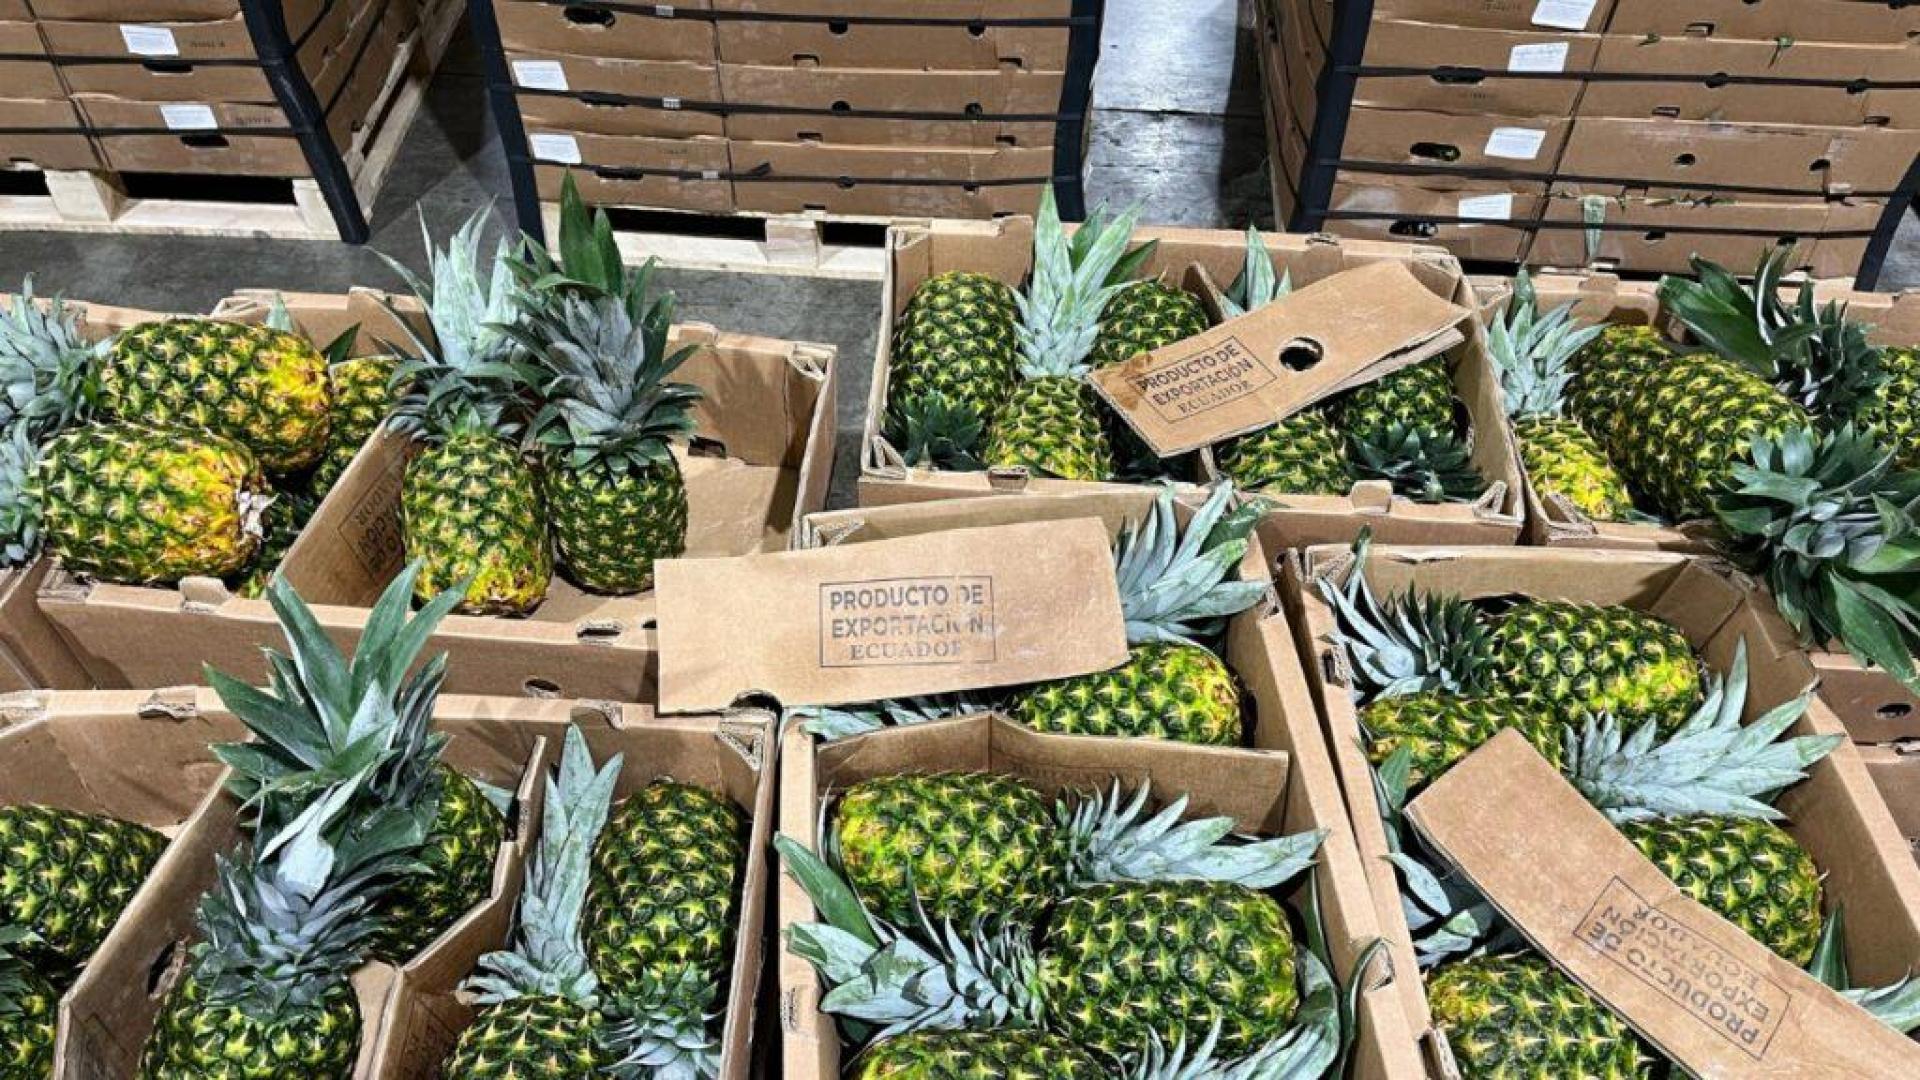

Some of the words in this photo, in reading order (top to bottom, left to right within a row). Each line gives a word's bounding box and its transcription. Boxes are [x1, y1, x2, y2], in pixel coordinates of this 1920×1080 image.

[1137, 354, 1216, 392] PRODUCTO
[1215, 344, 1240, 362] DE
[1178, 380, 1249, 413] ECUADOR
[830, 584, 949, 610] PRODUCTO
[1588, 921, 1622, 951] DE
[1627, 948, 1759, 1044] PRODUCTO
